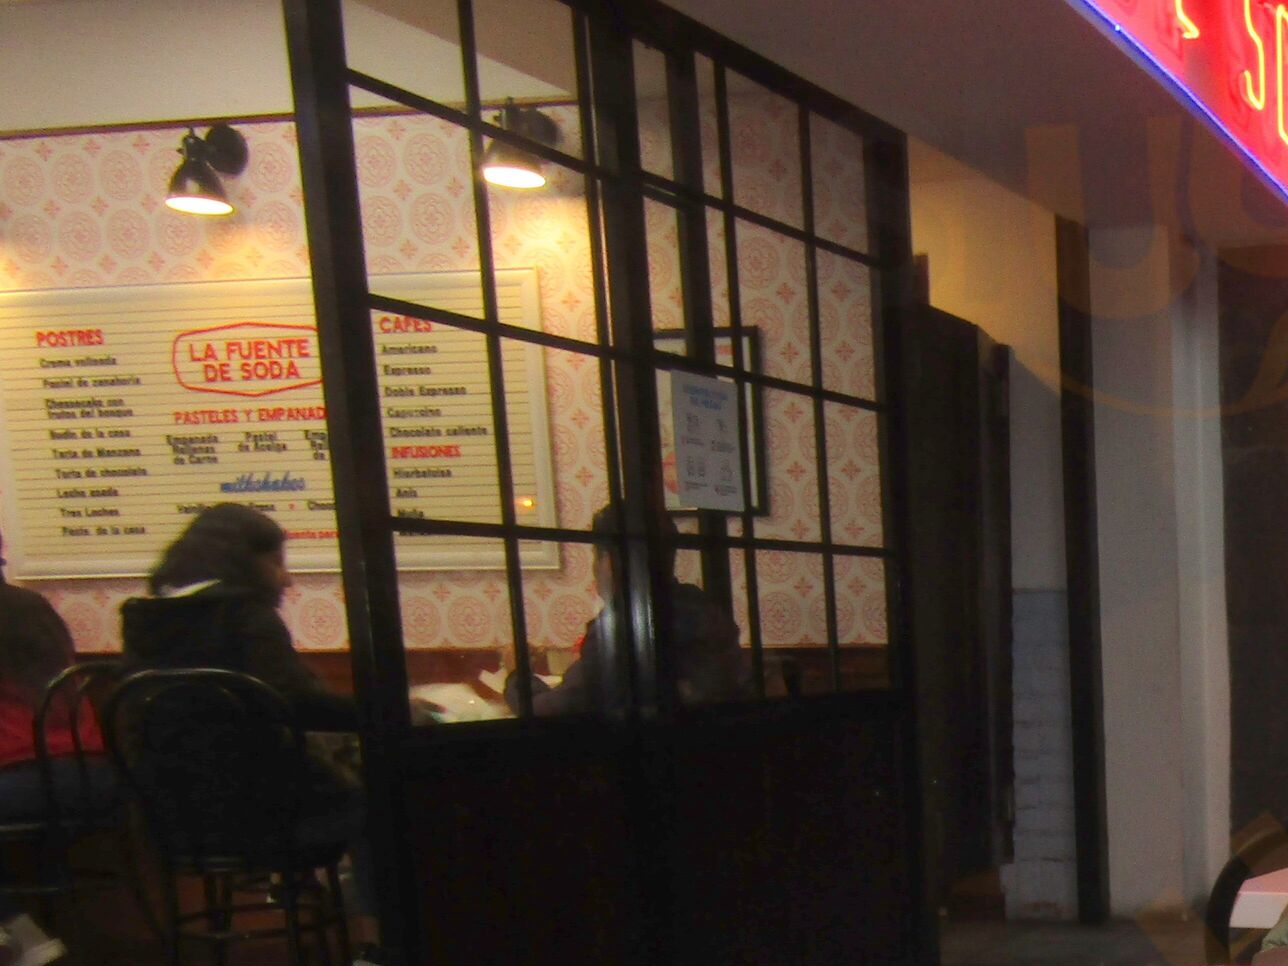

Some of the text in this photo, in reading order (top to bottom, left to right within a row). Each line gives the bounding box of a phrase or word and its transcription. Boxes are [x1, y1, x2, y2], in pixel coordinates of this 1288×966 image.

[36, 328, 104, 347] POSTRES
[189, 338, 311, 361] LA FUENTE
[204, 360, 301, 382] DE SODA
[78, 377, 89, 387] de
[174, 409, 240, 425] PASTELES
[245, 408, 253, 421] Y
[392, 445, 461, 458] INFUSIONES
